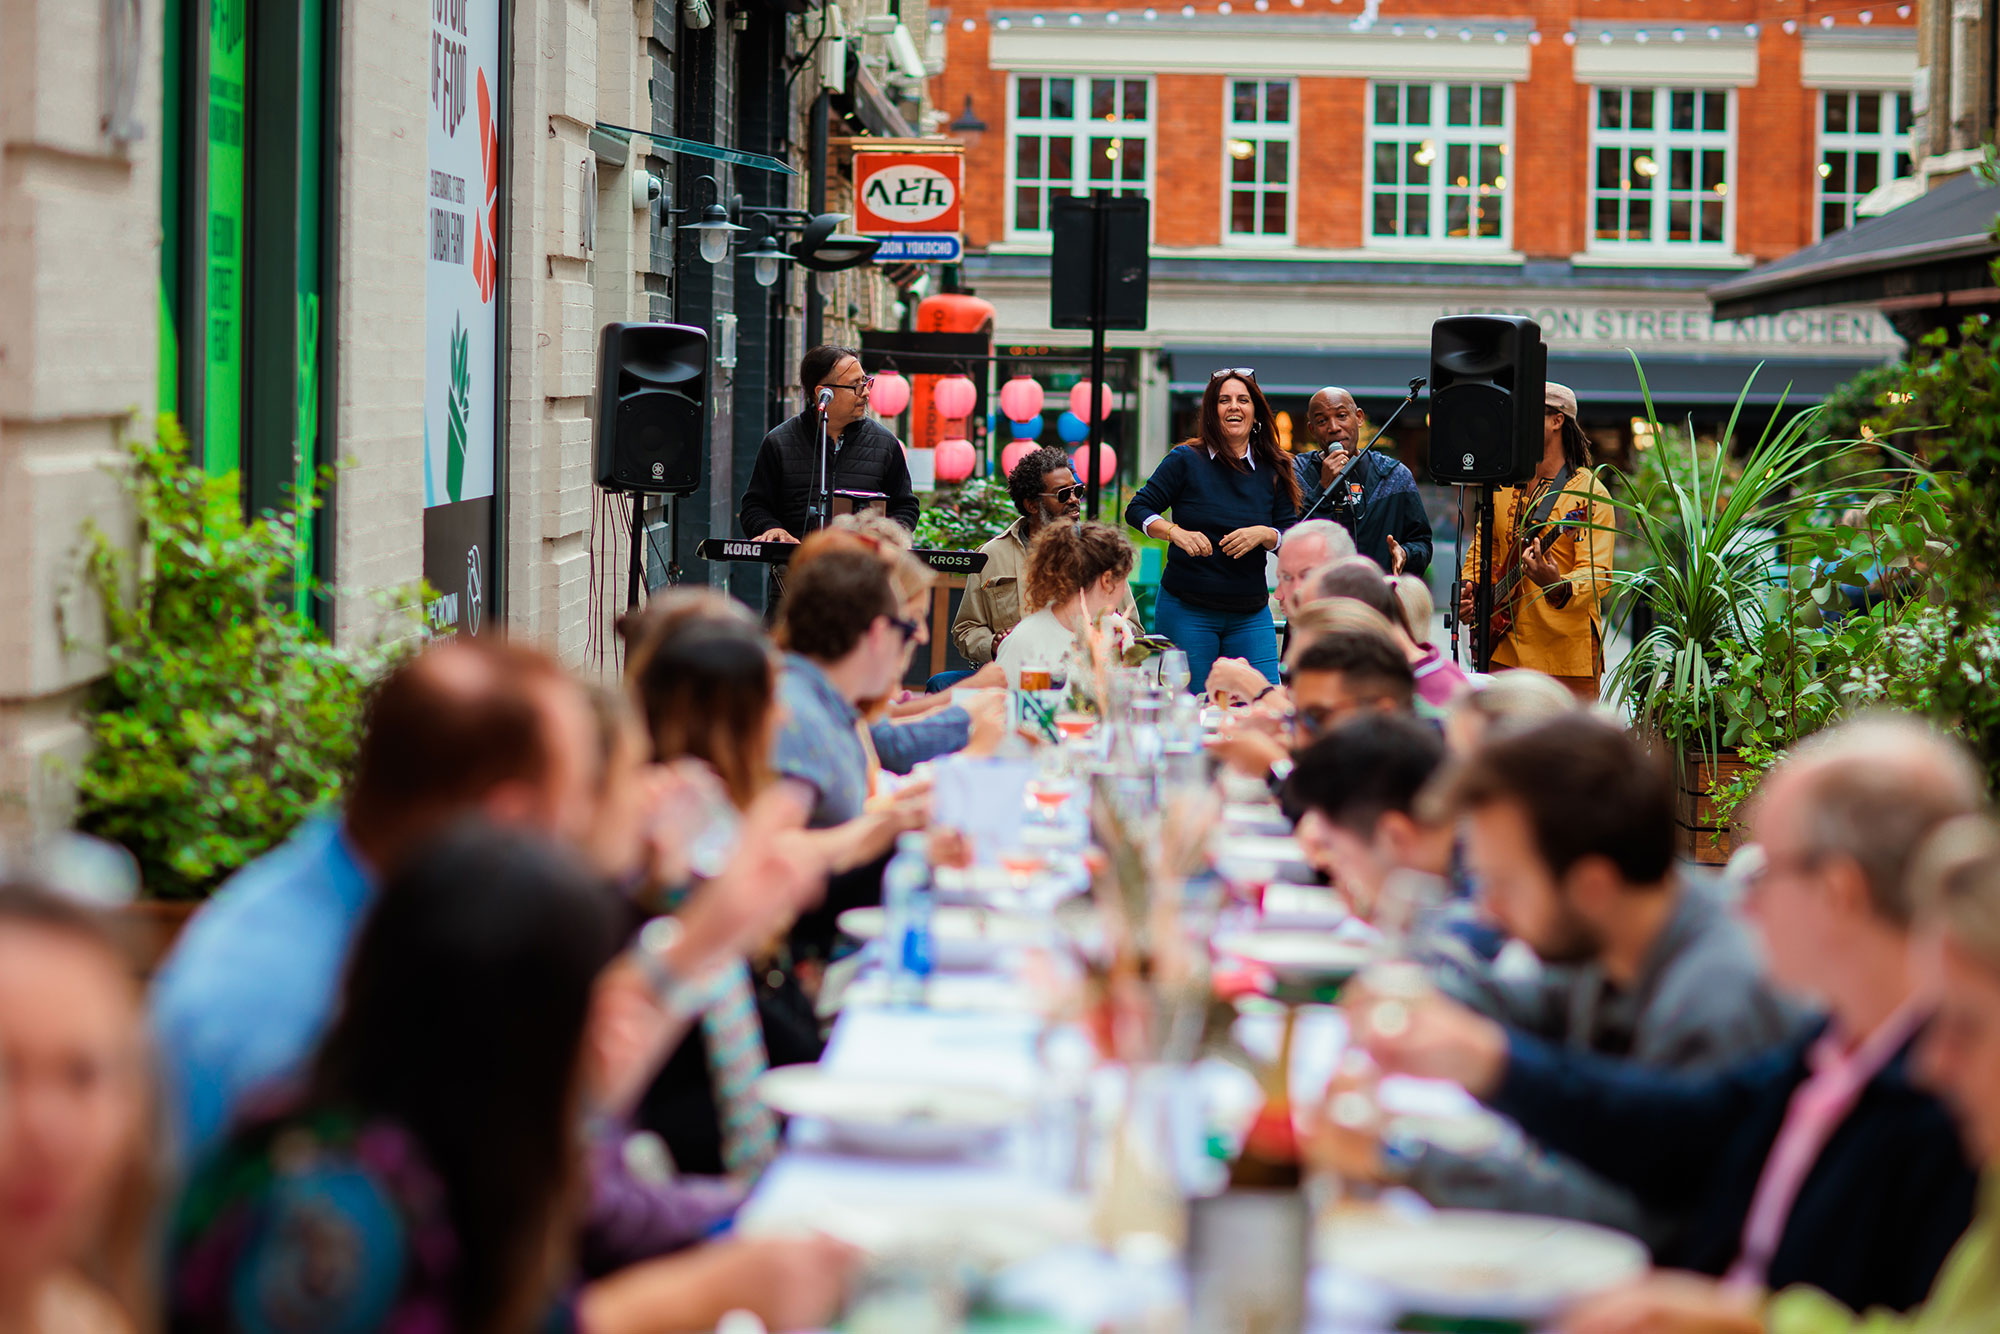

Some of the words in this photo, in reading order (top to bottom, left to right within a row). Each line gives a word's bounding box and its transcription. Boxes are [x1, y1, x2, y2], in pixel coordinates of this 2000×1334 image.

[431, 29, 441, 112] OF
[443, 37, 467, 139] FOOD
[906, 242, 952, 255] YOKOCHO
[1594, 309, 1715, 340] STREET
[1731, 311, 1873, 344] KITCHEN
[723, 542, 762, 557] KORG
[928, 554, 972, 567] KROSS
